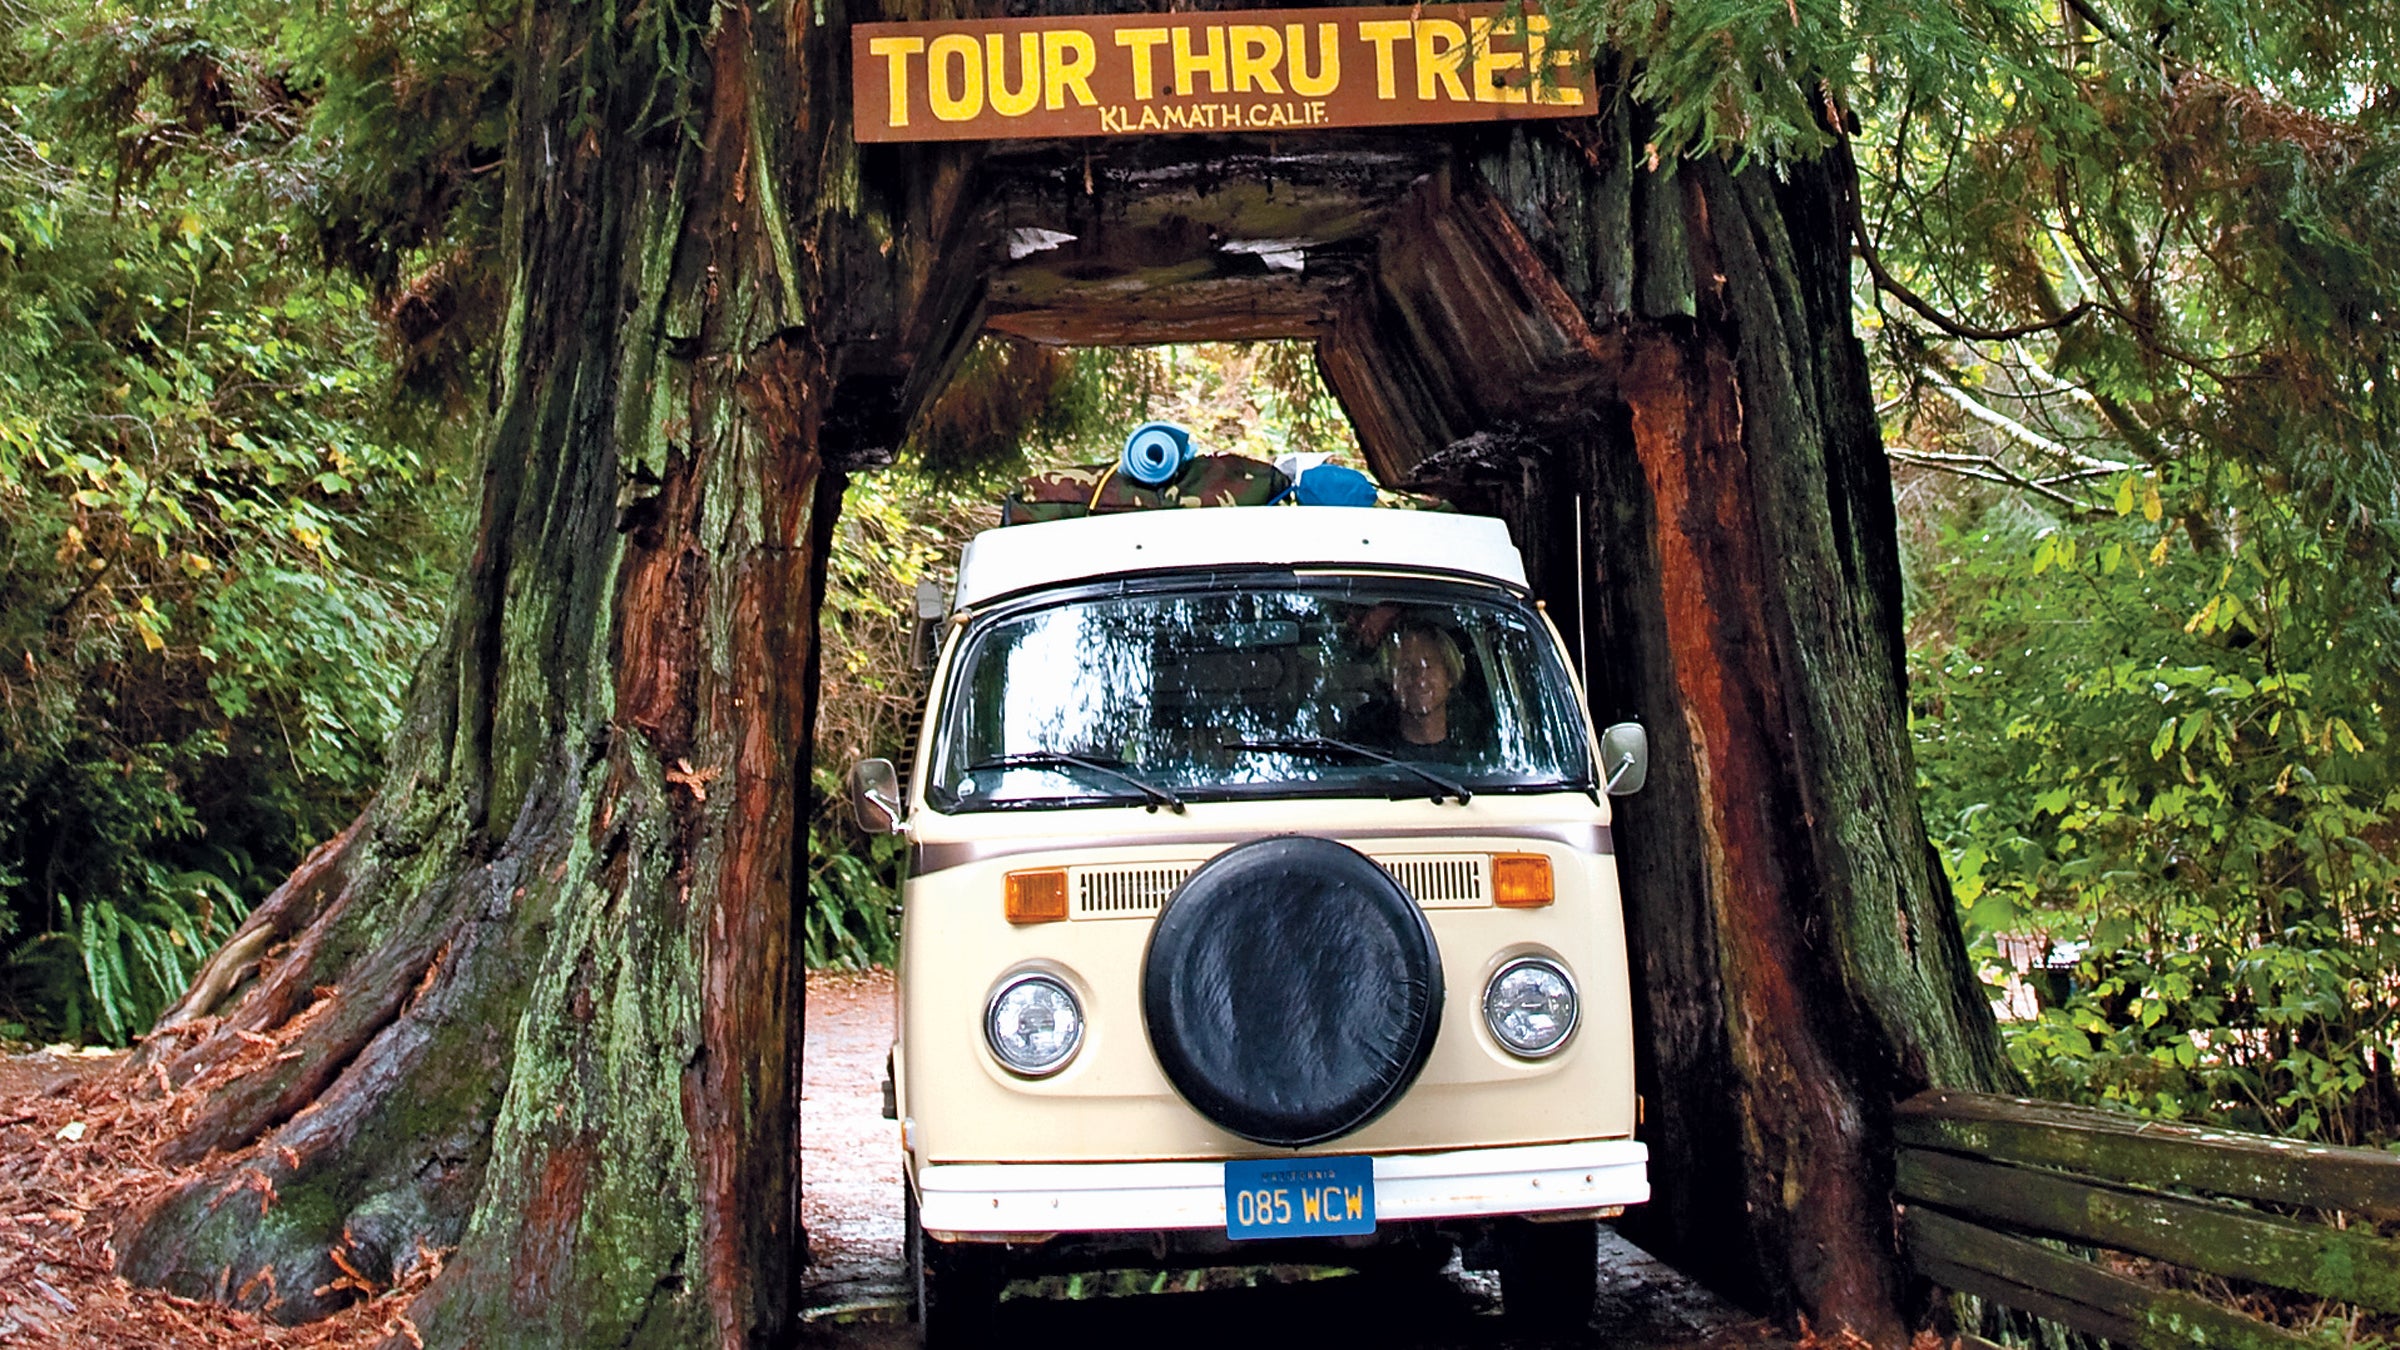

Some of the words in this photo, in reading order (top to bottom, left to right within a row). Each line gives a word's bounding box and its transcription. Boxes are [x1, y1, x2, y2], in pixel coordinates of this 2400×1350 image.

[869, 30, 1098, 127] TOUR
[1114, 23, 1340, 100] THRU
[1358, 14, 1584, 106] TREE
[1237, 1190, 1291, 1226] 085
[1301, 1185, 1363, 1223] WCW
